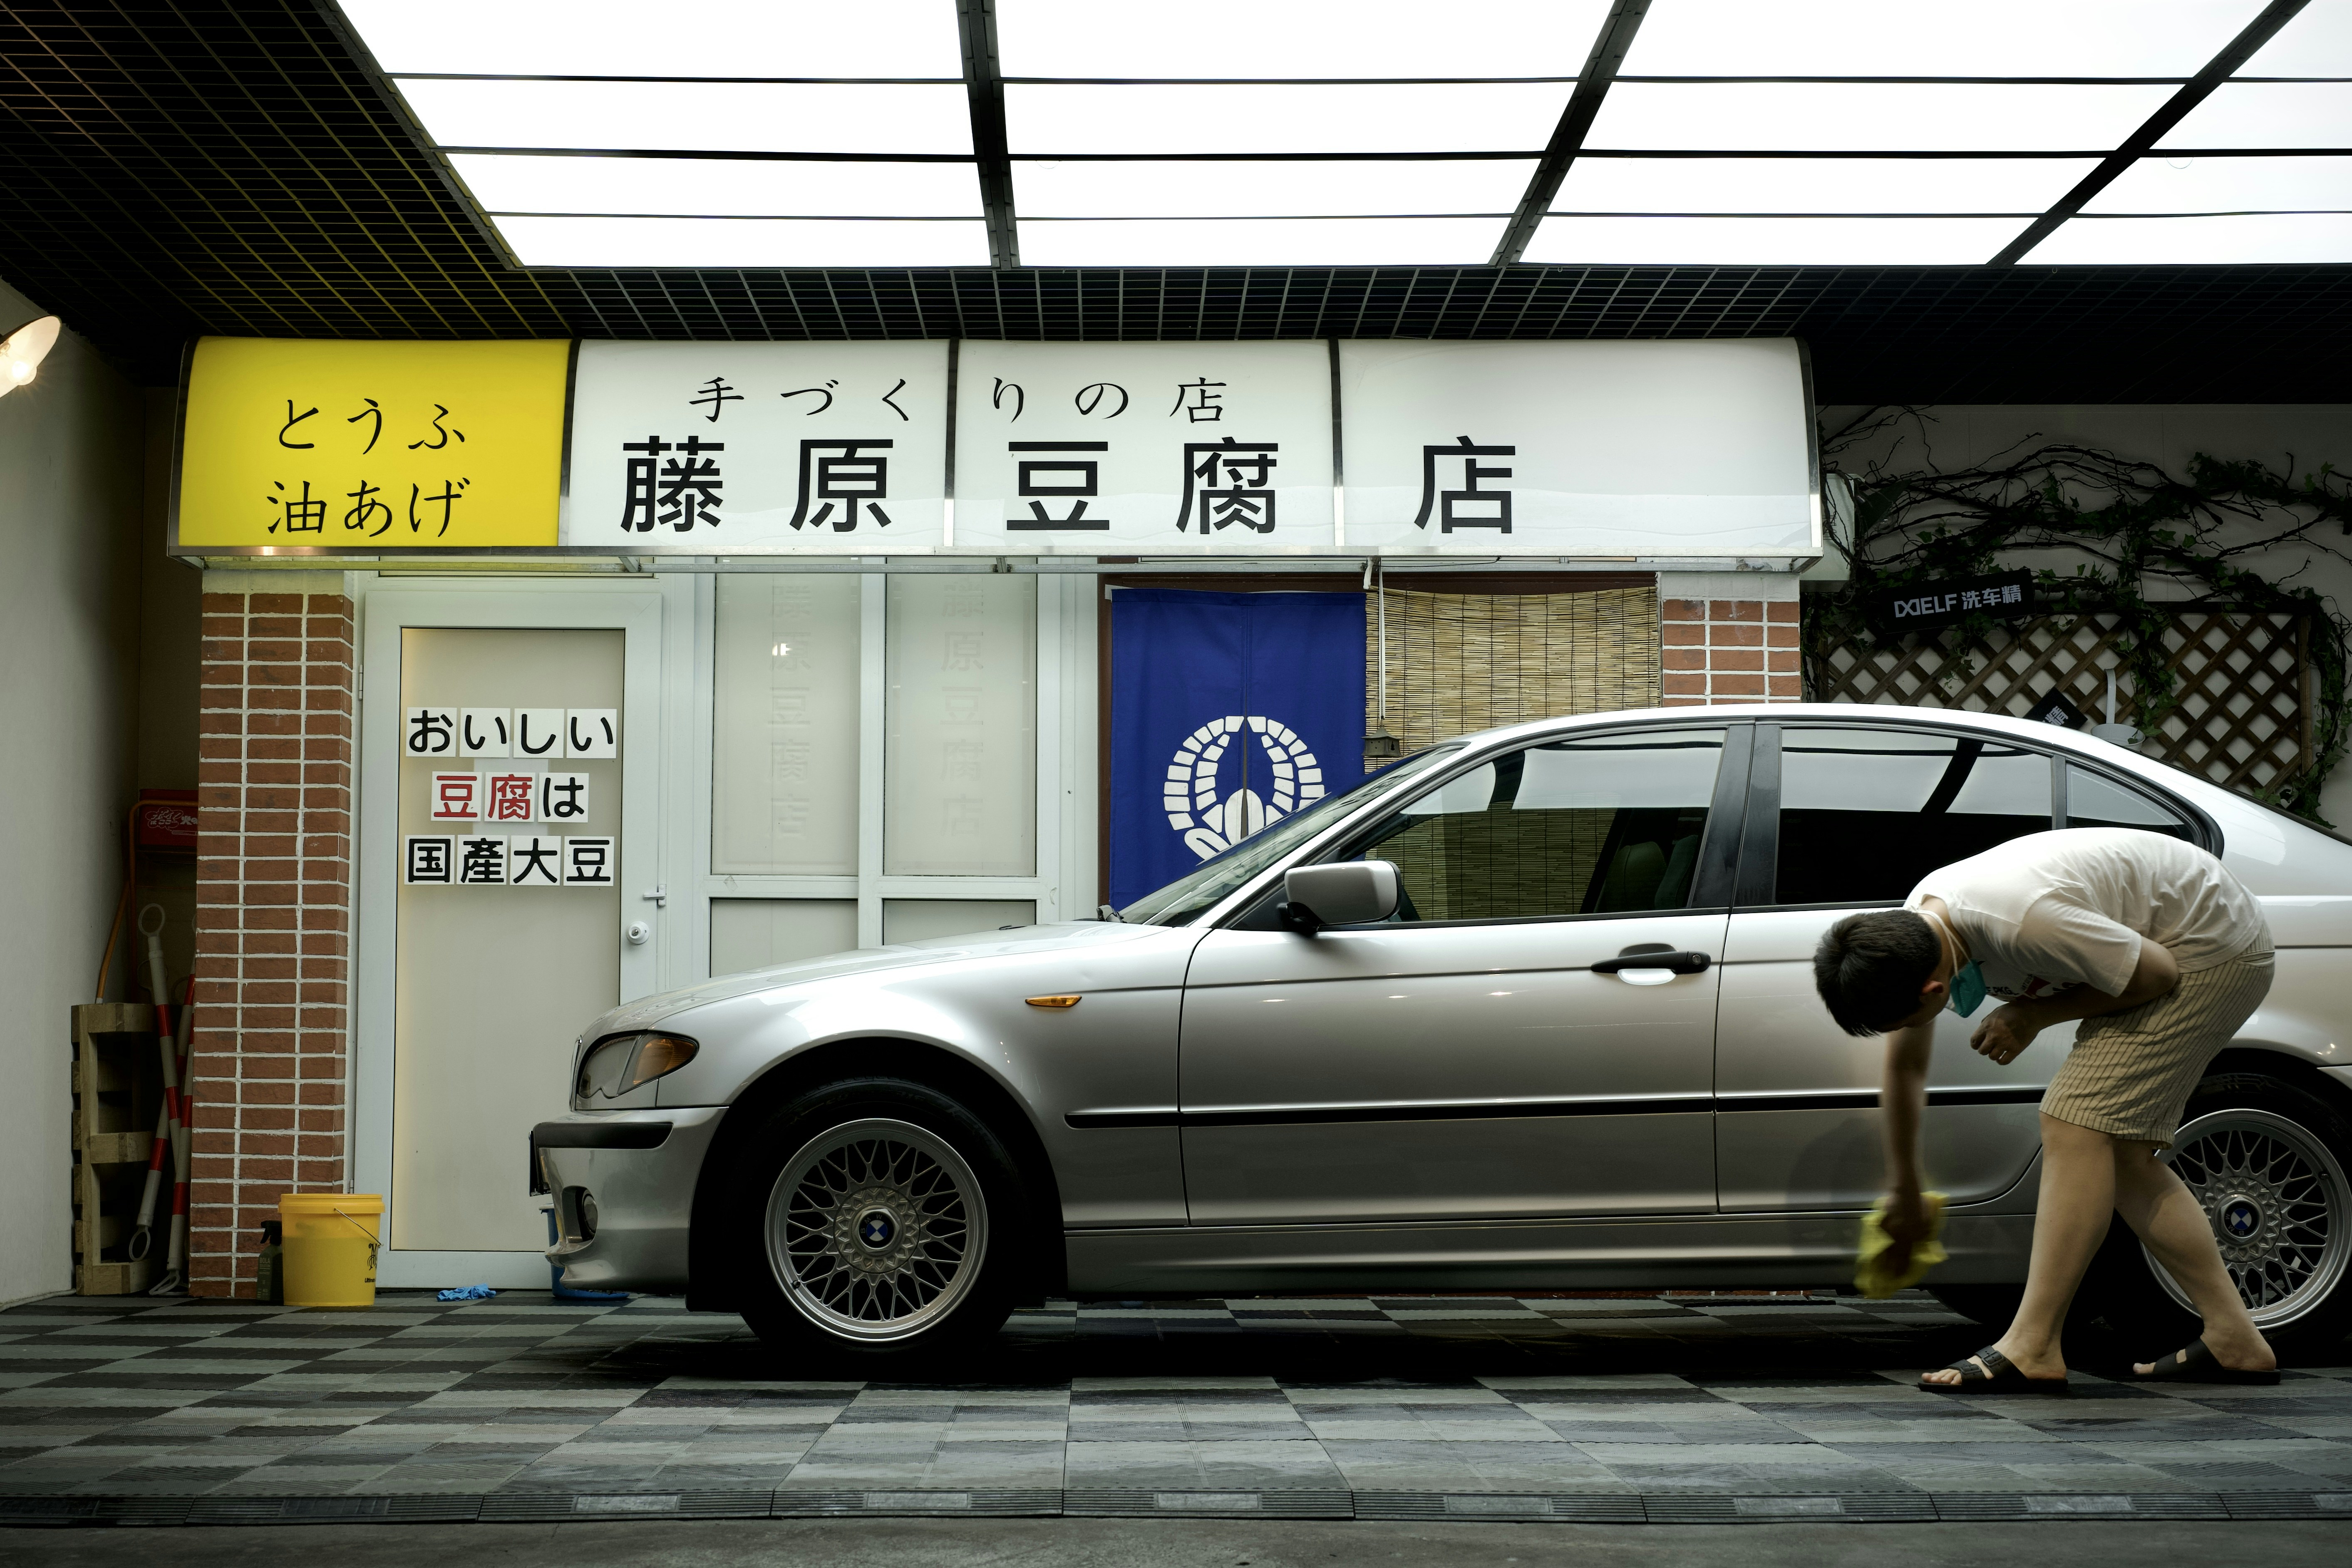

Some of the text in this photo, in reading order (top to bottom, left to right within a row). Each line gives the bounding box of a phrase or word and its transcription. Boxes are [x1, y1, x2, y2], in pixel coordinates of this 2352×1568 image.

[688, 376, 1227, 424] 手づくりの店
[278, 398, 465, 455] とうふ
[266, 477, 471, 538] 油あげ
[620, 435, 1516, 535] 藤原豆腐店
[1961, 585, 2022, 610] 洗车精
[409, 710, 613, 754] おいしい
[2042, 705, 2069, 726] 精
[434, 774, 584, 820] 豆腐は
[860, 1214, 883, 1234] BMW
[2225, 1213, 2245, 1236] BMW
